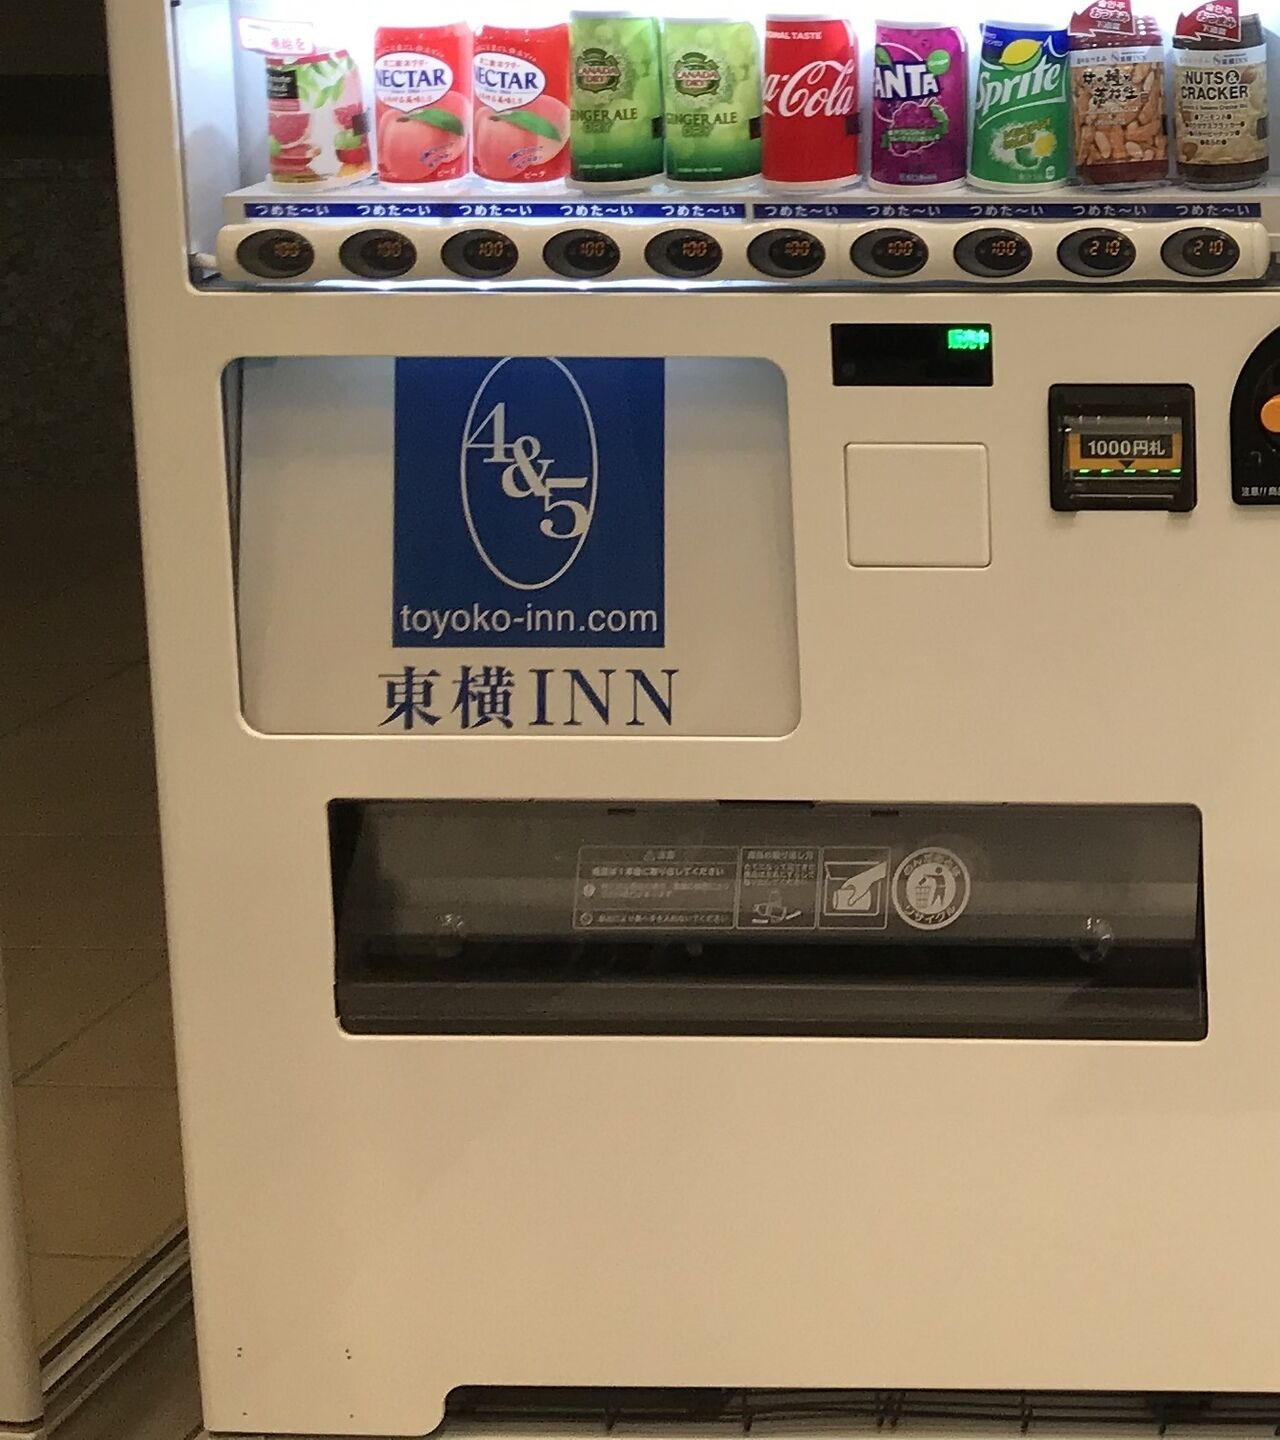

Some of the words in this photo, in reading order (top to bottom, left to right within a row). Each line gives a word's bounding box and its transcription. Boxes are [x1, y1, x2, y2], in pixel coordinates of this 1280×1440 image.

[376, 68, 447, 88] NECTAR
[674, 68, 720, 80] CANADA
[976, 63, 1062, 115] Sprite
[1182, 86, 1249, 101] CRACKER
[714, 111, 738, 124] ALE
[1087, 438, 1165, 458] 1000円札
[462, 402, 590, 540] 4&5
[400, 602, 658, 640] toyoko-inn.com
[377, 664, 680, 732] 東横INN
